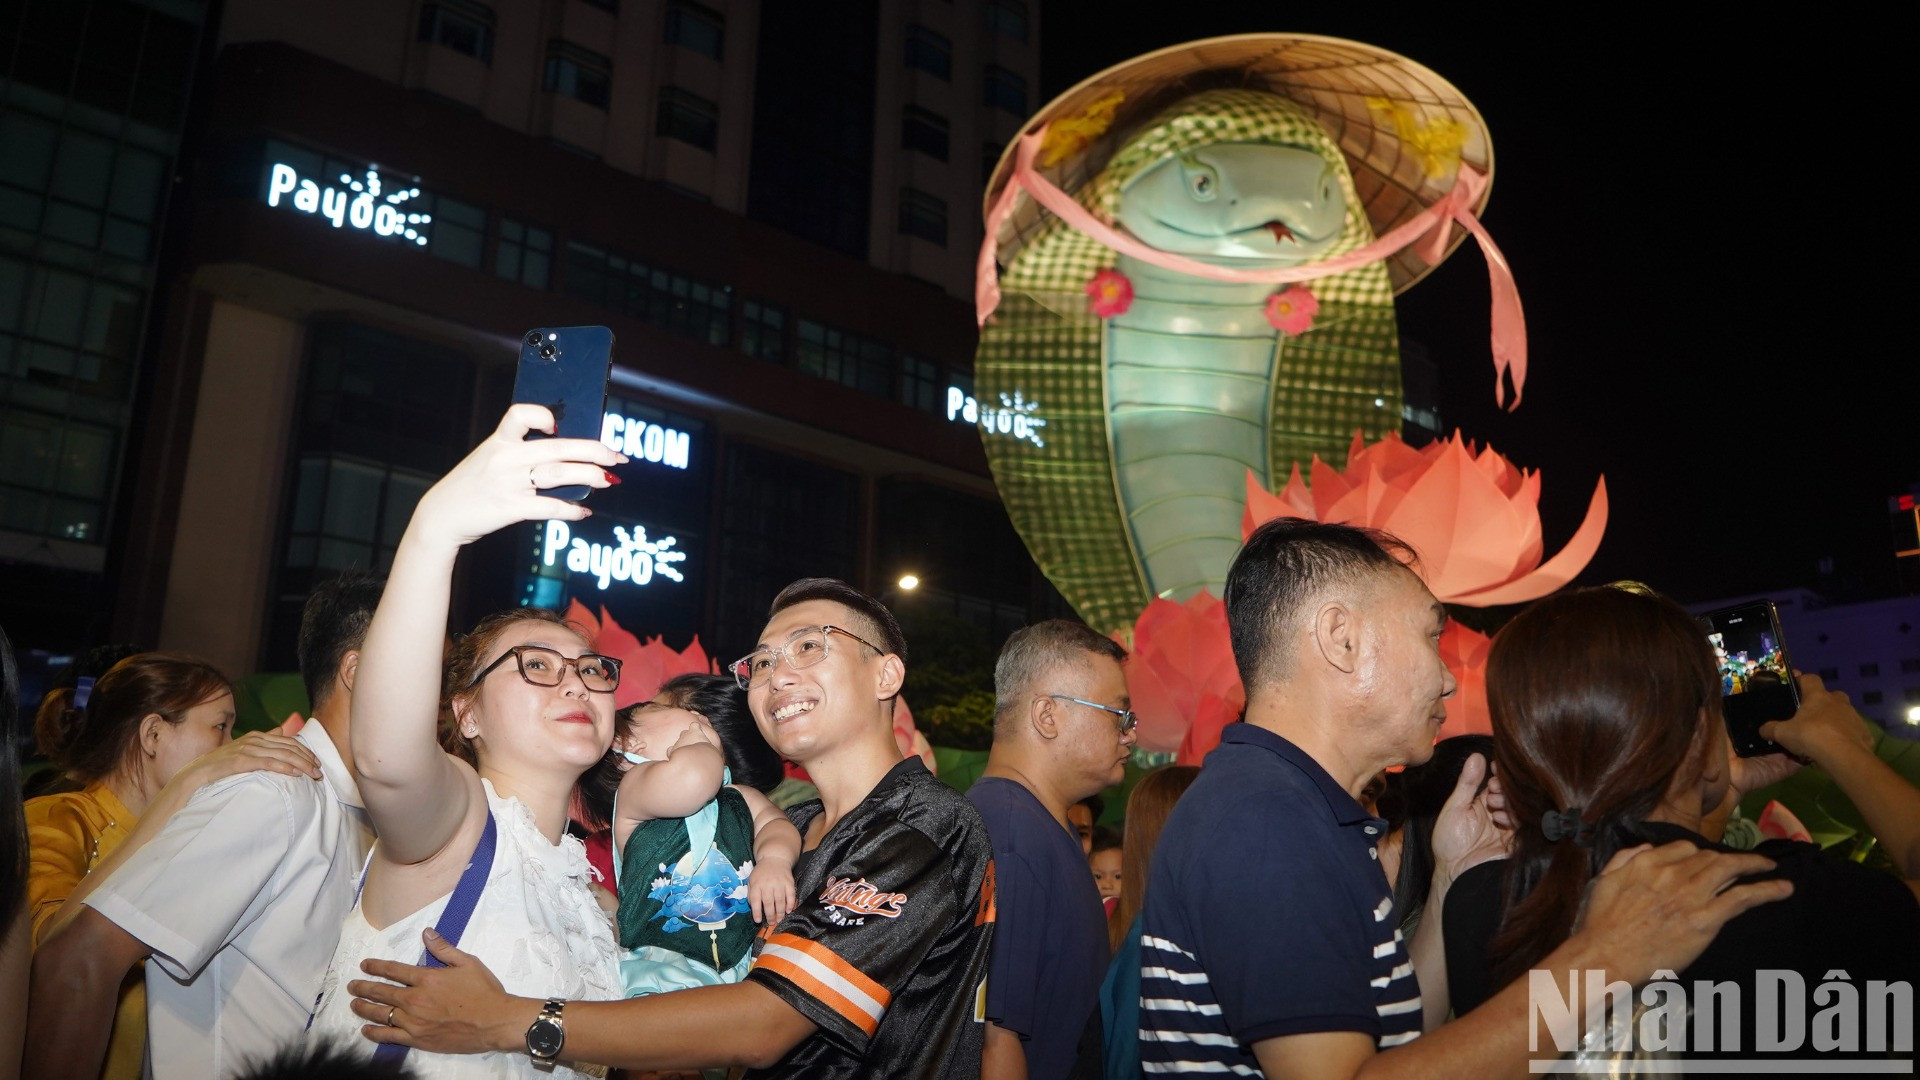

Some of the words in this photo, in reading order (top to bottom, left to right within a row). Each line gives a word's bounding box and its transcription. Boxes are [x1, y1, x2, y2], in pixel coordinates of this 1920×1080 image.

[268, 163, 398, 236] Payoo
[600, 412, 690, 469] CKOM
[947, 386, 1028, 439] Payoo
[544, 519, 654, 590] Payoo
